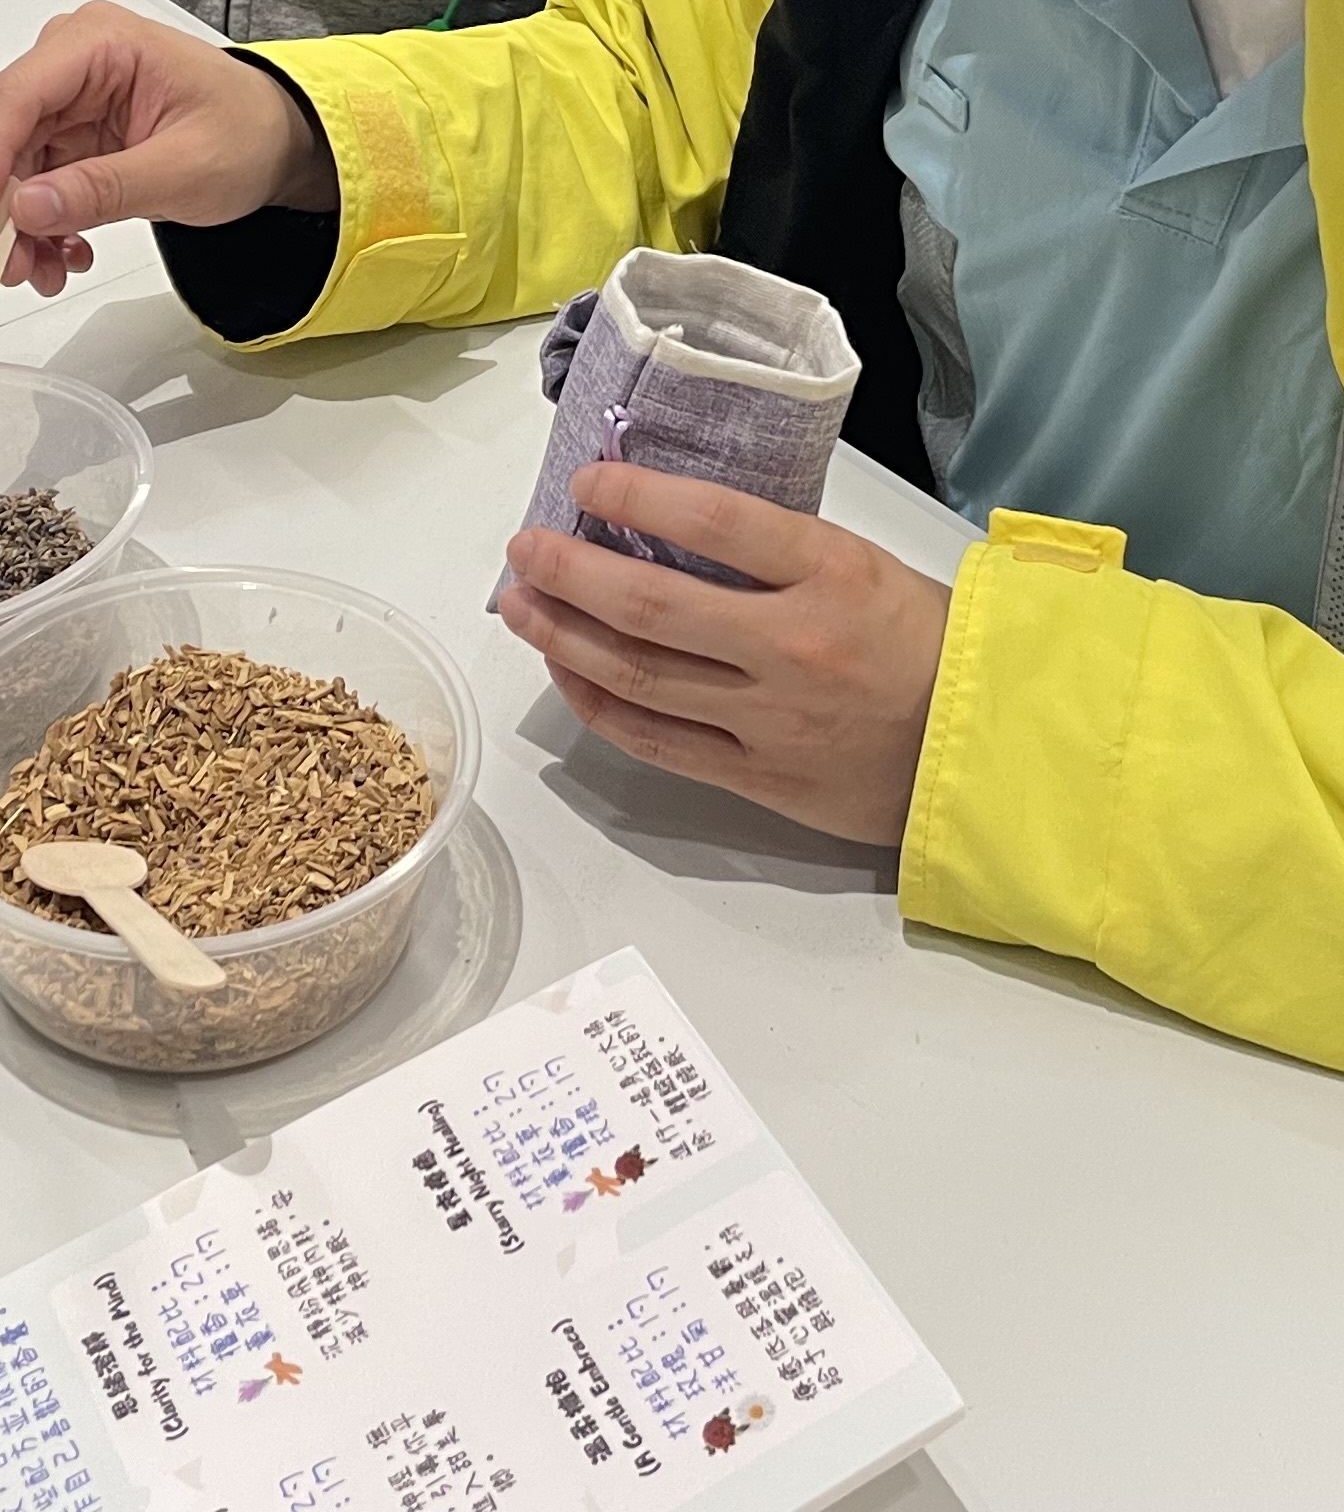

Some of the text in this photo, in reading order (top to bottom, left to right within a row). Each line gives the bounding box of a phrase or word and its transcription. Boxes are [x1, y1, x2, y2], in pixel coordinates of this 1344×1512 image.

[417, 1099, 526, 1256] (Starry Night Healing)
[92, 1271, 190, 1443] (Clarity for the Mind)
[550, 1317, 663, 1478] (A Gentle Embrace)
